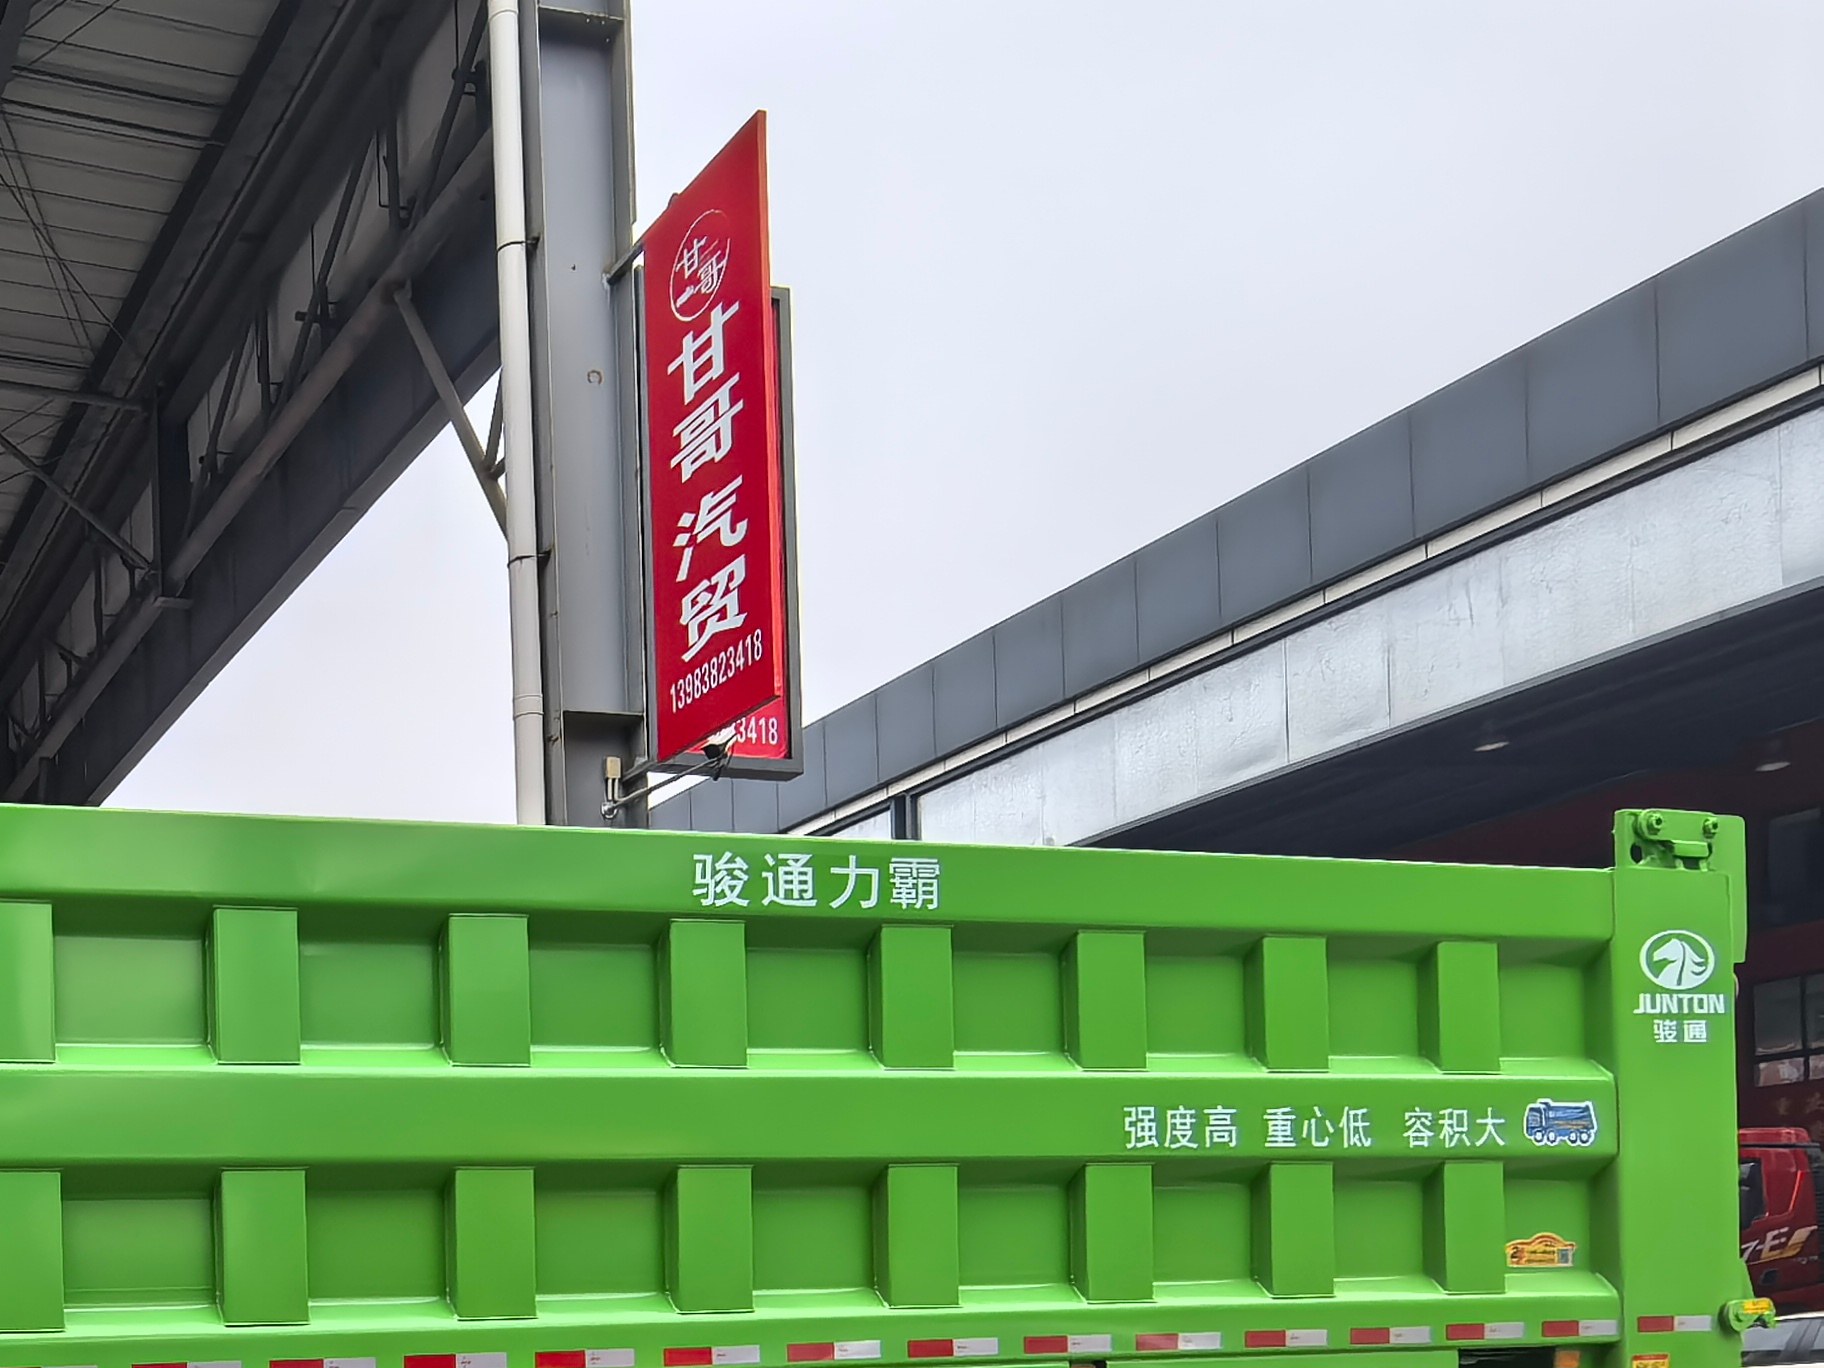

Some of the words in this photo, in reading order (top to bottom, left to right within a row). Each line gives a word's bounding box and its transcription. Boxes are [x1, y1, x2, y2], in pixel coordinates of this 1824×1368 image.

[667, 301, 748, 662] 甘哥汽贸
[670, 629, 762, 713] 13983823418
[692, 850, 941, 911] 骏通力霸
[1633, 993, 1725, 1014] JUNTON
[1653, 1019, 1707, 1043] 骏通
[1123, 1105, 1238, 1149] 强度高
[1263, 1106, 1372, 1149] 重心低
[1403, 1106, 1506, 1149] 容积大
